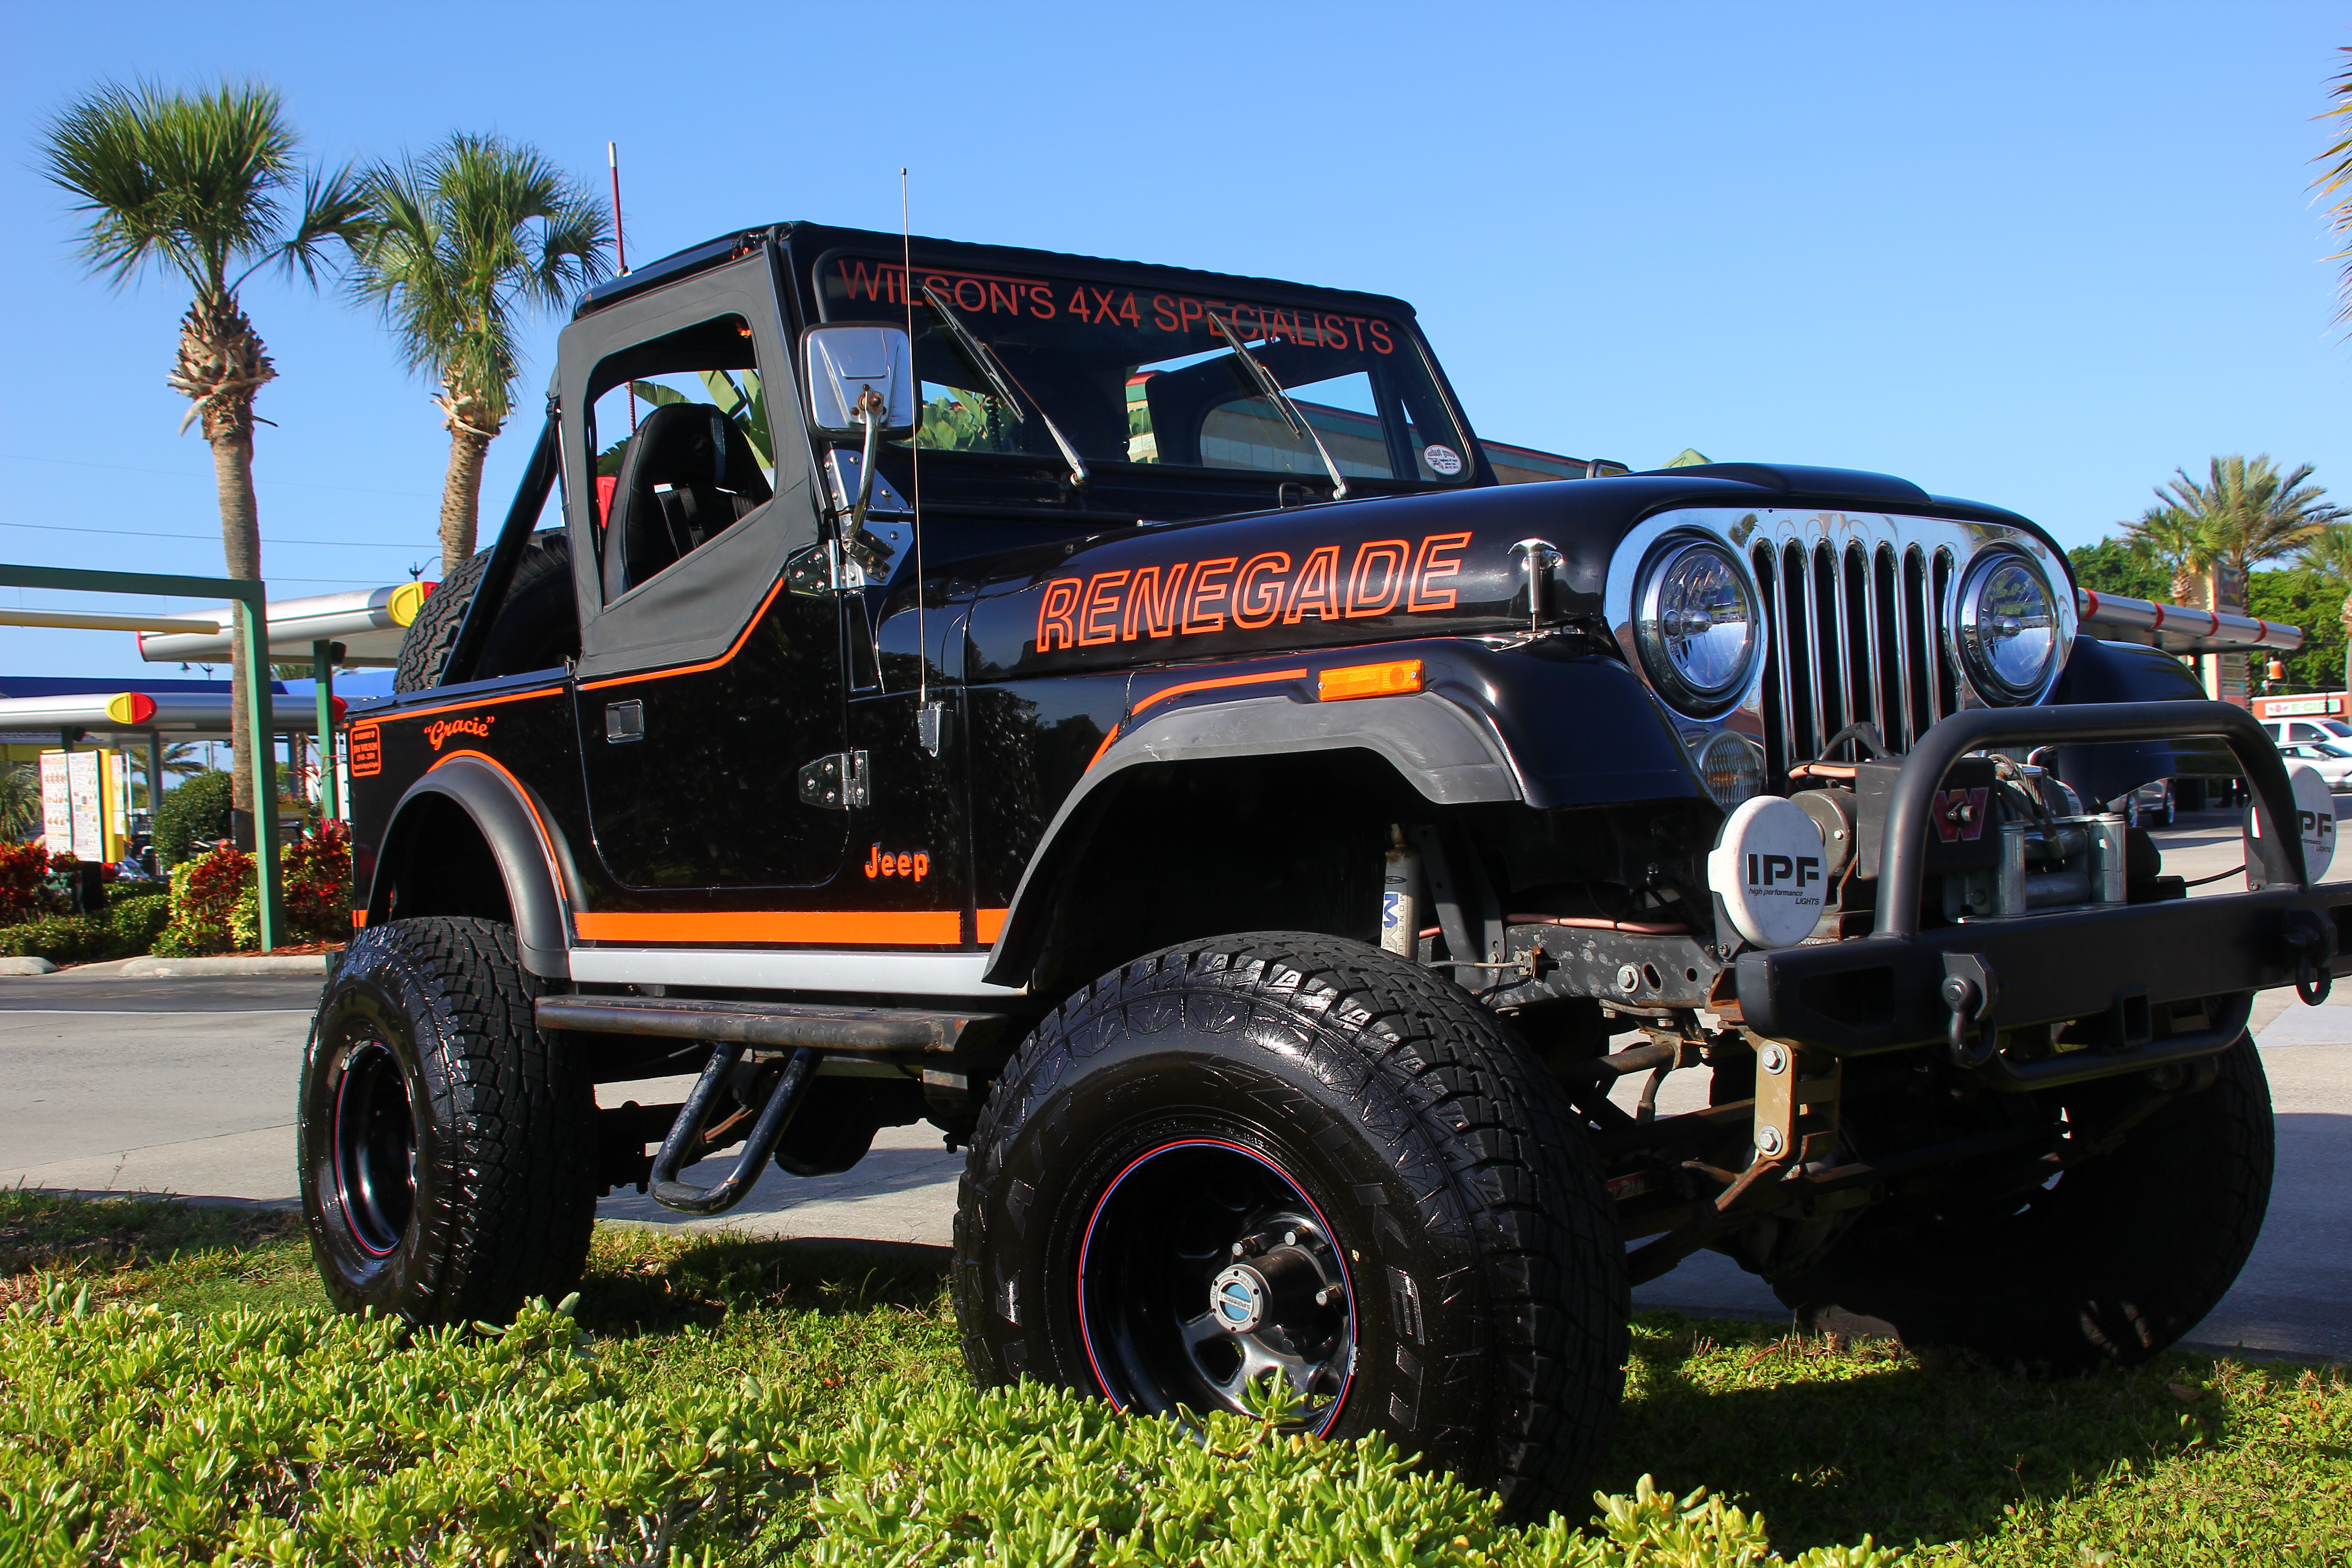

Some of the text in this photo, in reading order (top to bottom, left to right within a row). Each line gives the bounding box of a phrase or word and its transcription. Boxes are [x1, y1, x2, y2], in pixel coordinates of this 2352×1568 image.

[838, 260, 1393, 353] WILSON'S 4X4 SPECIALISTS
[1037, 531, 1472, 652] RENEGADE
[2292, 701, 2338, 712] E-CIGS
[2297, 810, 2331, 838] PF
[865, 843, 930, 882] Jeep
[1747, 854, 1819, 887] IPF
[1795, 897, 1819, 906] LIGHTS
